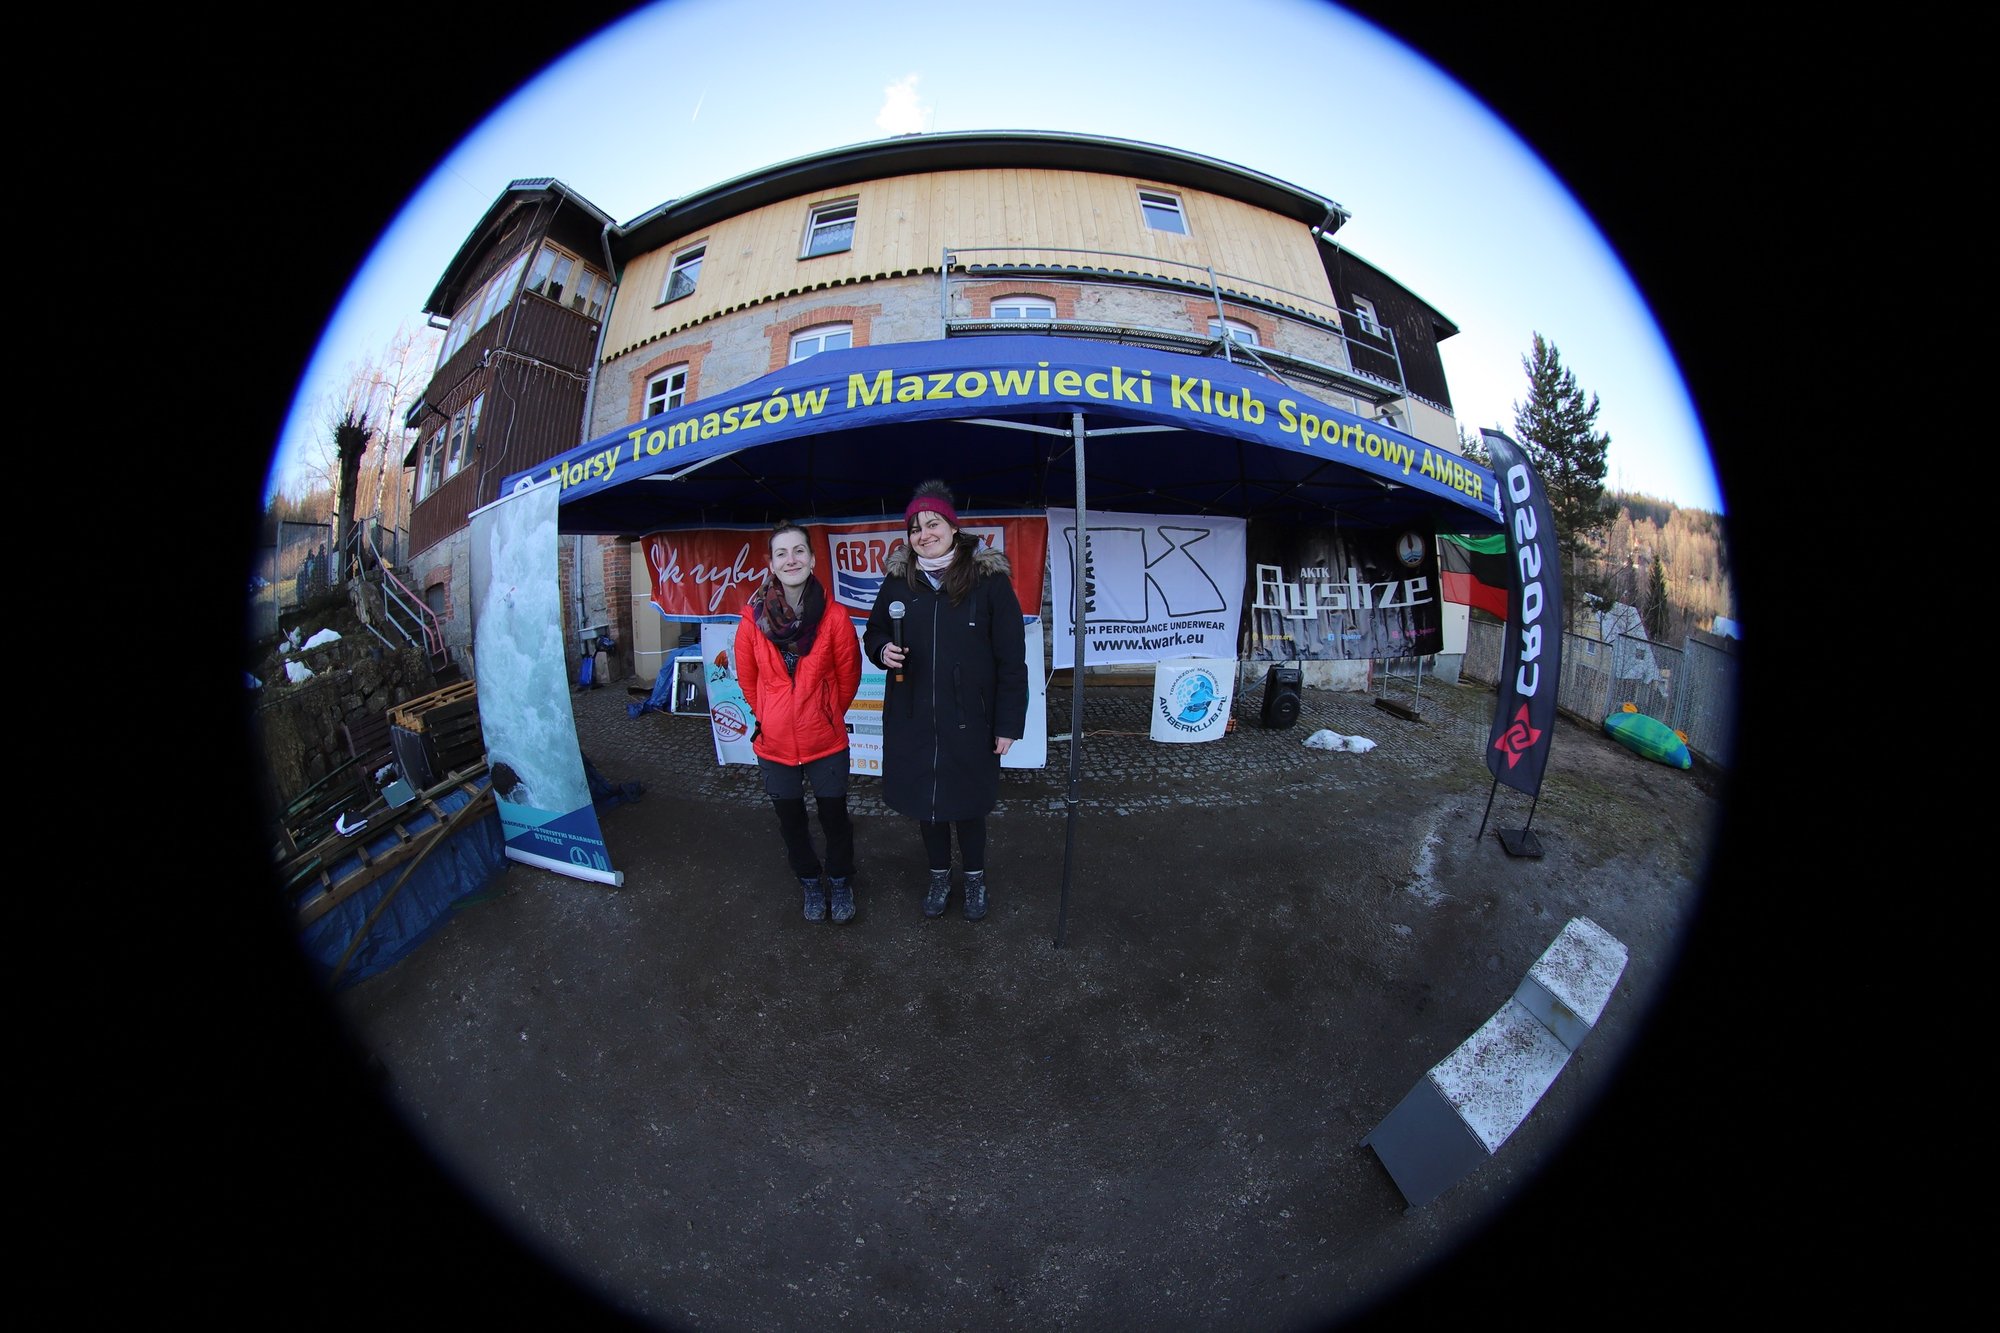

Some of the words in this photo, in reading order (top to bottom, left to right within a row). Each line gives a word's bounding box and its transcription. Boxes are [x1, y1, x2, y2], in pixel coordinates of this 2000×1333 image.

[551, 444, 620, 491] Morsy
[628, 387, 829, 463] Tomaszów
[847, 361, 1154, 409] Mazowiecki
[1171, 375, 1266, 425] Klub
[1279, 398, 1416, 475] Sportowy
[1420, 449, 1484, 502] AMBER
[1300, 567, 1330, 578] AKTK
[1068, 624, 1097, 637] HH
[1099, 622, 1168, 635] PERFORMANCE
[1170, 619, 1226, 632] UNDERWEAR
[1092, 631, 1205, 652] www.kwark.eu
[714, 712, 743, 730] TNP
[1159, 695, 1228, 733] AMBERKLUB.PL
